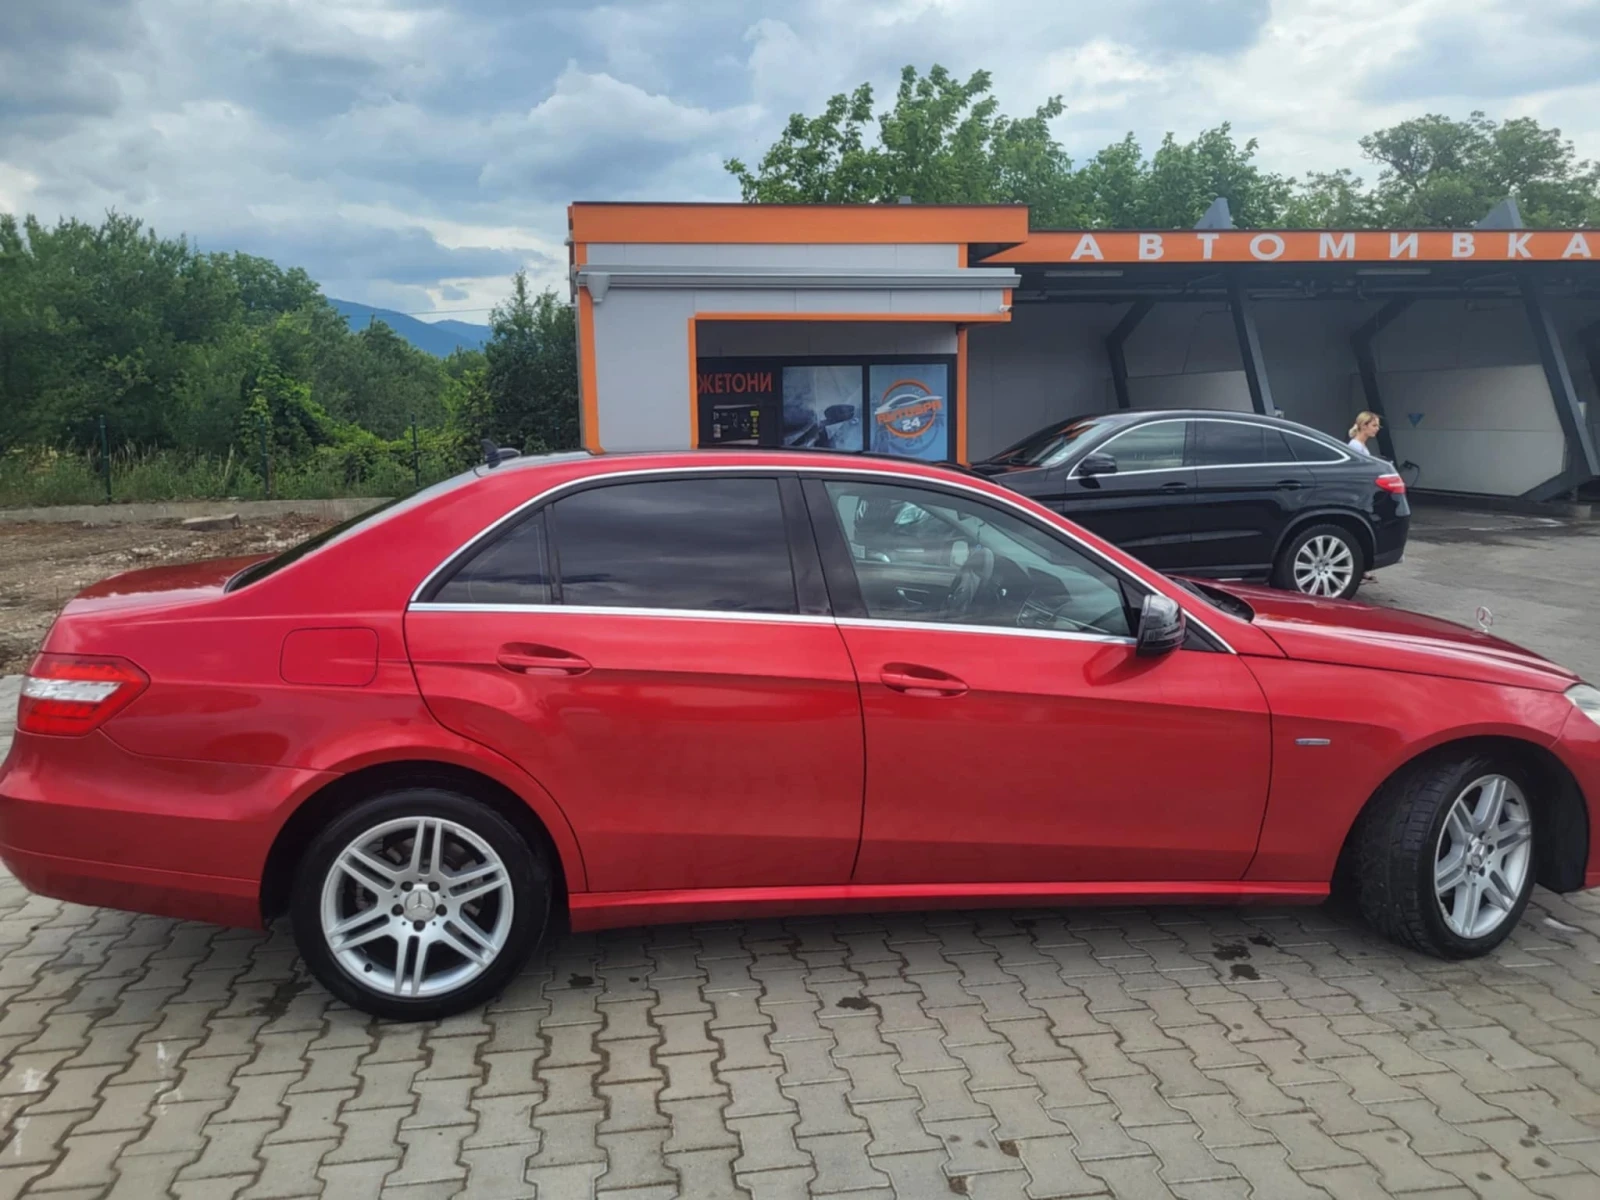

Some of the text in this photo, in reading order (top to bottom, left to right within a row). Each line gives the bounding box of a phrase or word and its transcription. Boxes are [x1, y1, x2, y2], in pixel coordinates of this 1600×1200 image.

[1070, 232, 1592, 260] АВТОМИВКА
[698, 372, 772, 394] ЖЕТОНИ
[901, 417, 921, 431] 24
